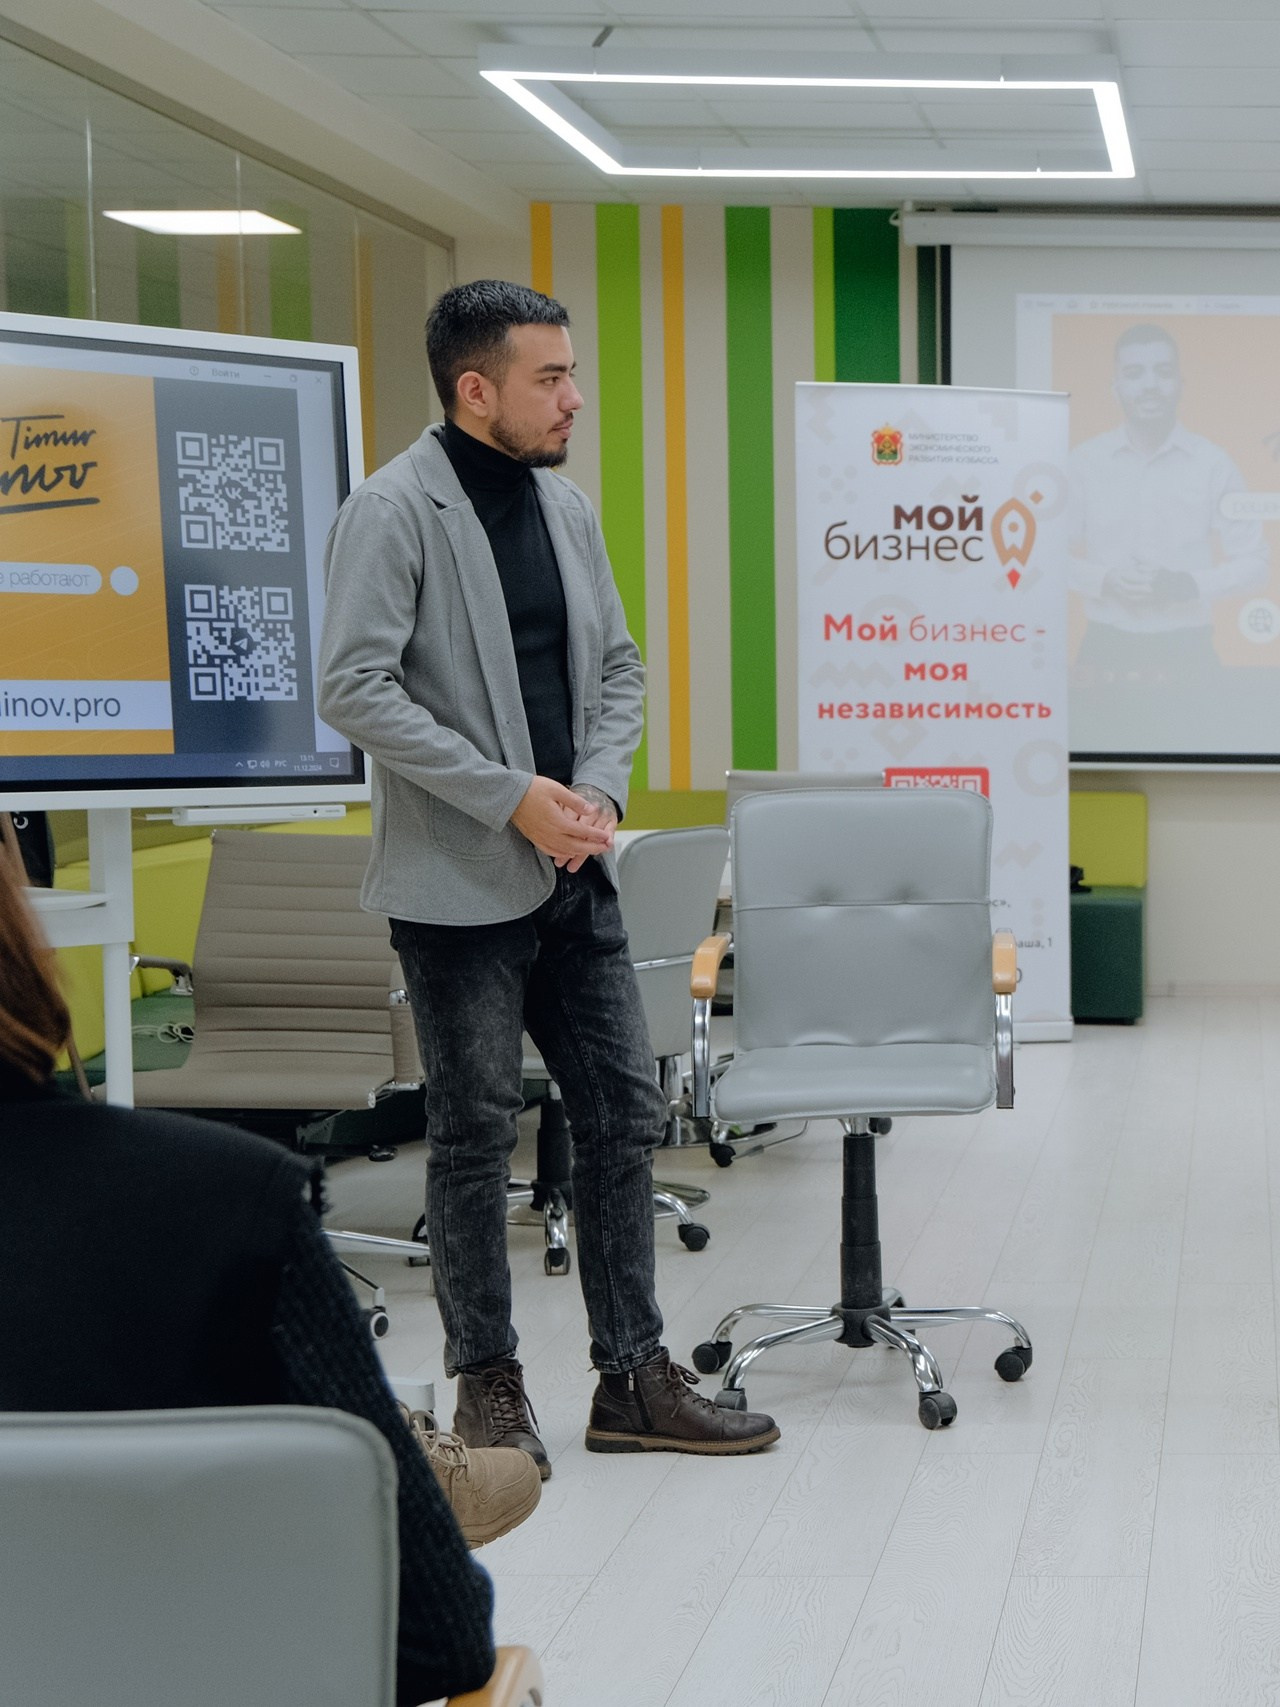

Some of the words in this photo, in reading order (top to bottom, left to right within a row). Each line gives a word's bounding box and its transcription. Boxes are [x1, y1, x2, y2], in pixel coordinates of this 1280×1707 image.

[0, 414, 97, 460] Timur
[893, 494, 984, 532] мой
[824, 521, 984, 562] бизнес
[9, 569, 91, 588] работают
[823, 614, 898, 642] Мой
[908, 615, 1026, 643] бизнес
[904, 662, 968, 681] моя
[0, 690, 121, 723] inov.pro
[818, 701, 1052, 720] независимость
